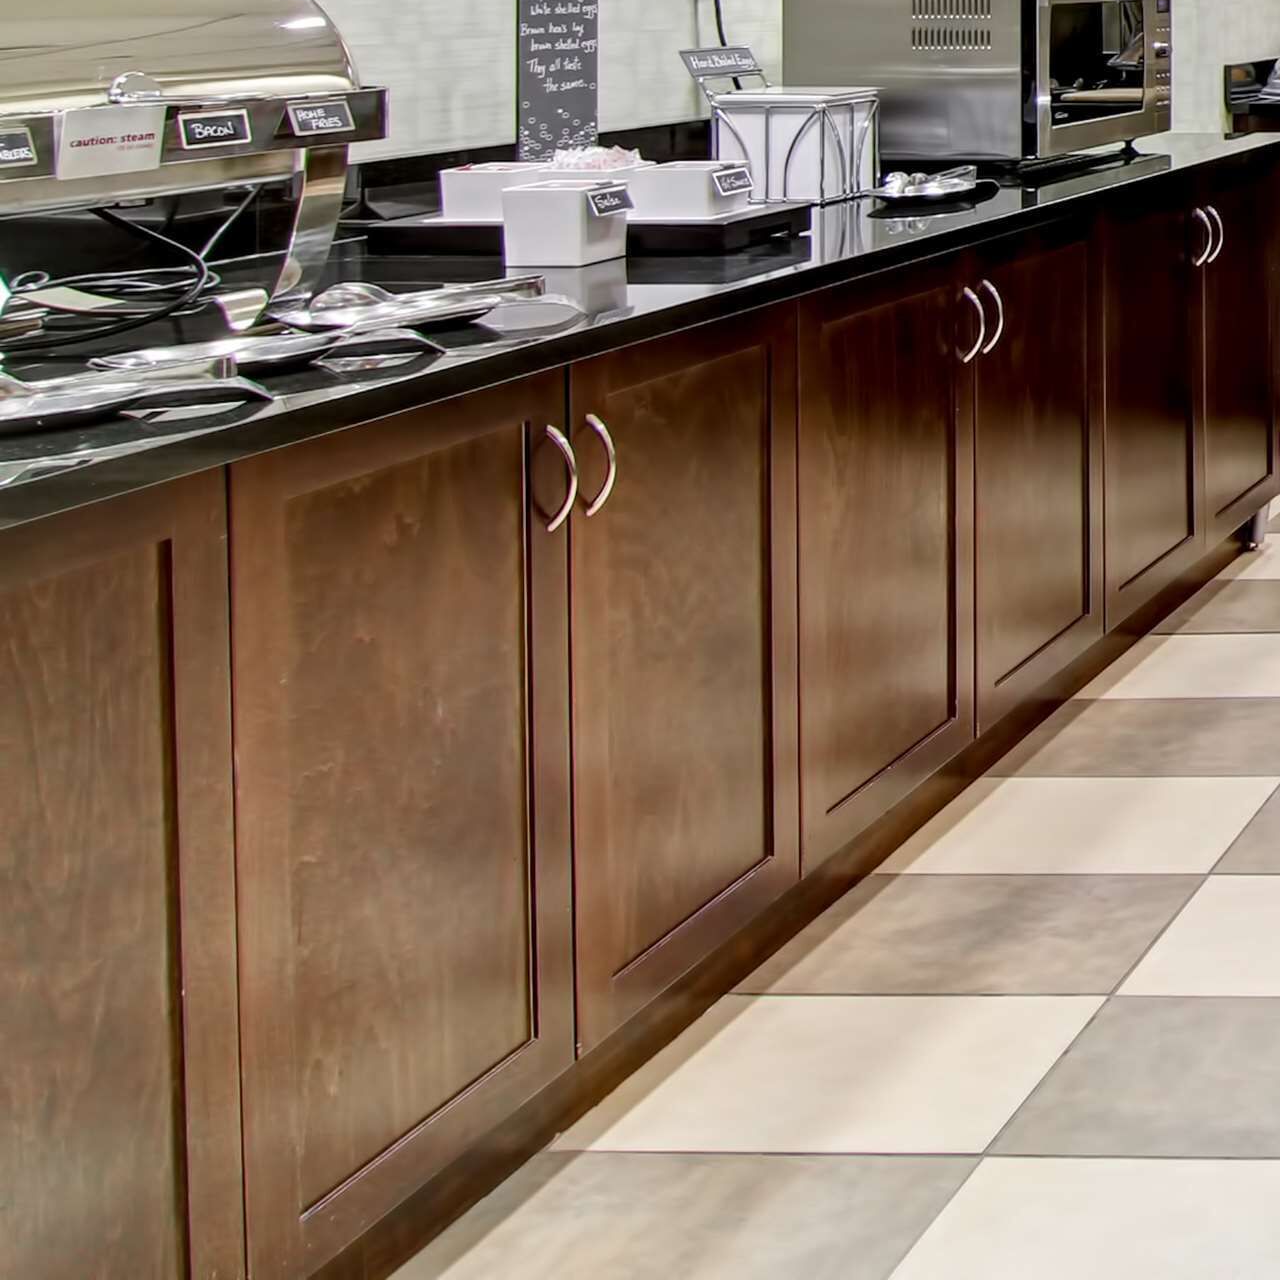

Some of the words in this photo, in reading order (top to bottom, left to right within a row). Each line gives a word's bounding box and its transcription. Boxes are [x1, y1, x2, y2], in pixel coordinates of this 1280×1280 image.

[555, 2, 580, 14] shelled
[582, 4, 598, 19] eggs
[520, 23, 545, 36] Brown
[572, 22, 584, 37] lay
[526, 58, 546, 78] They
[549, 57, 561, 72] all
[543, 77, 559, 93] the
[297, 108, 326, 122] HOME
[191, 122, 234, 139] BACON
[311, 117, 343, 131] FRIES
[70, 136, 117, 148] caution:
[120, 132, 155, 144] steam
[594, 194, 622, 209] Salsa
